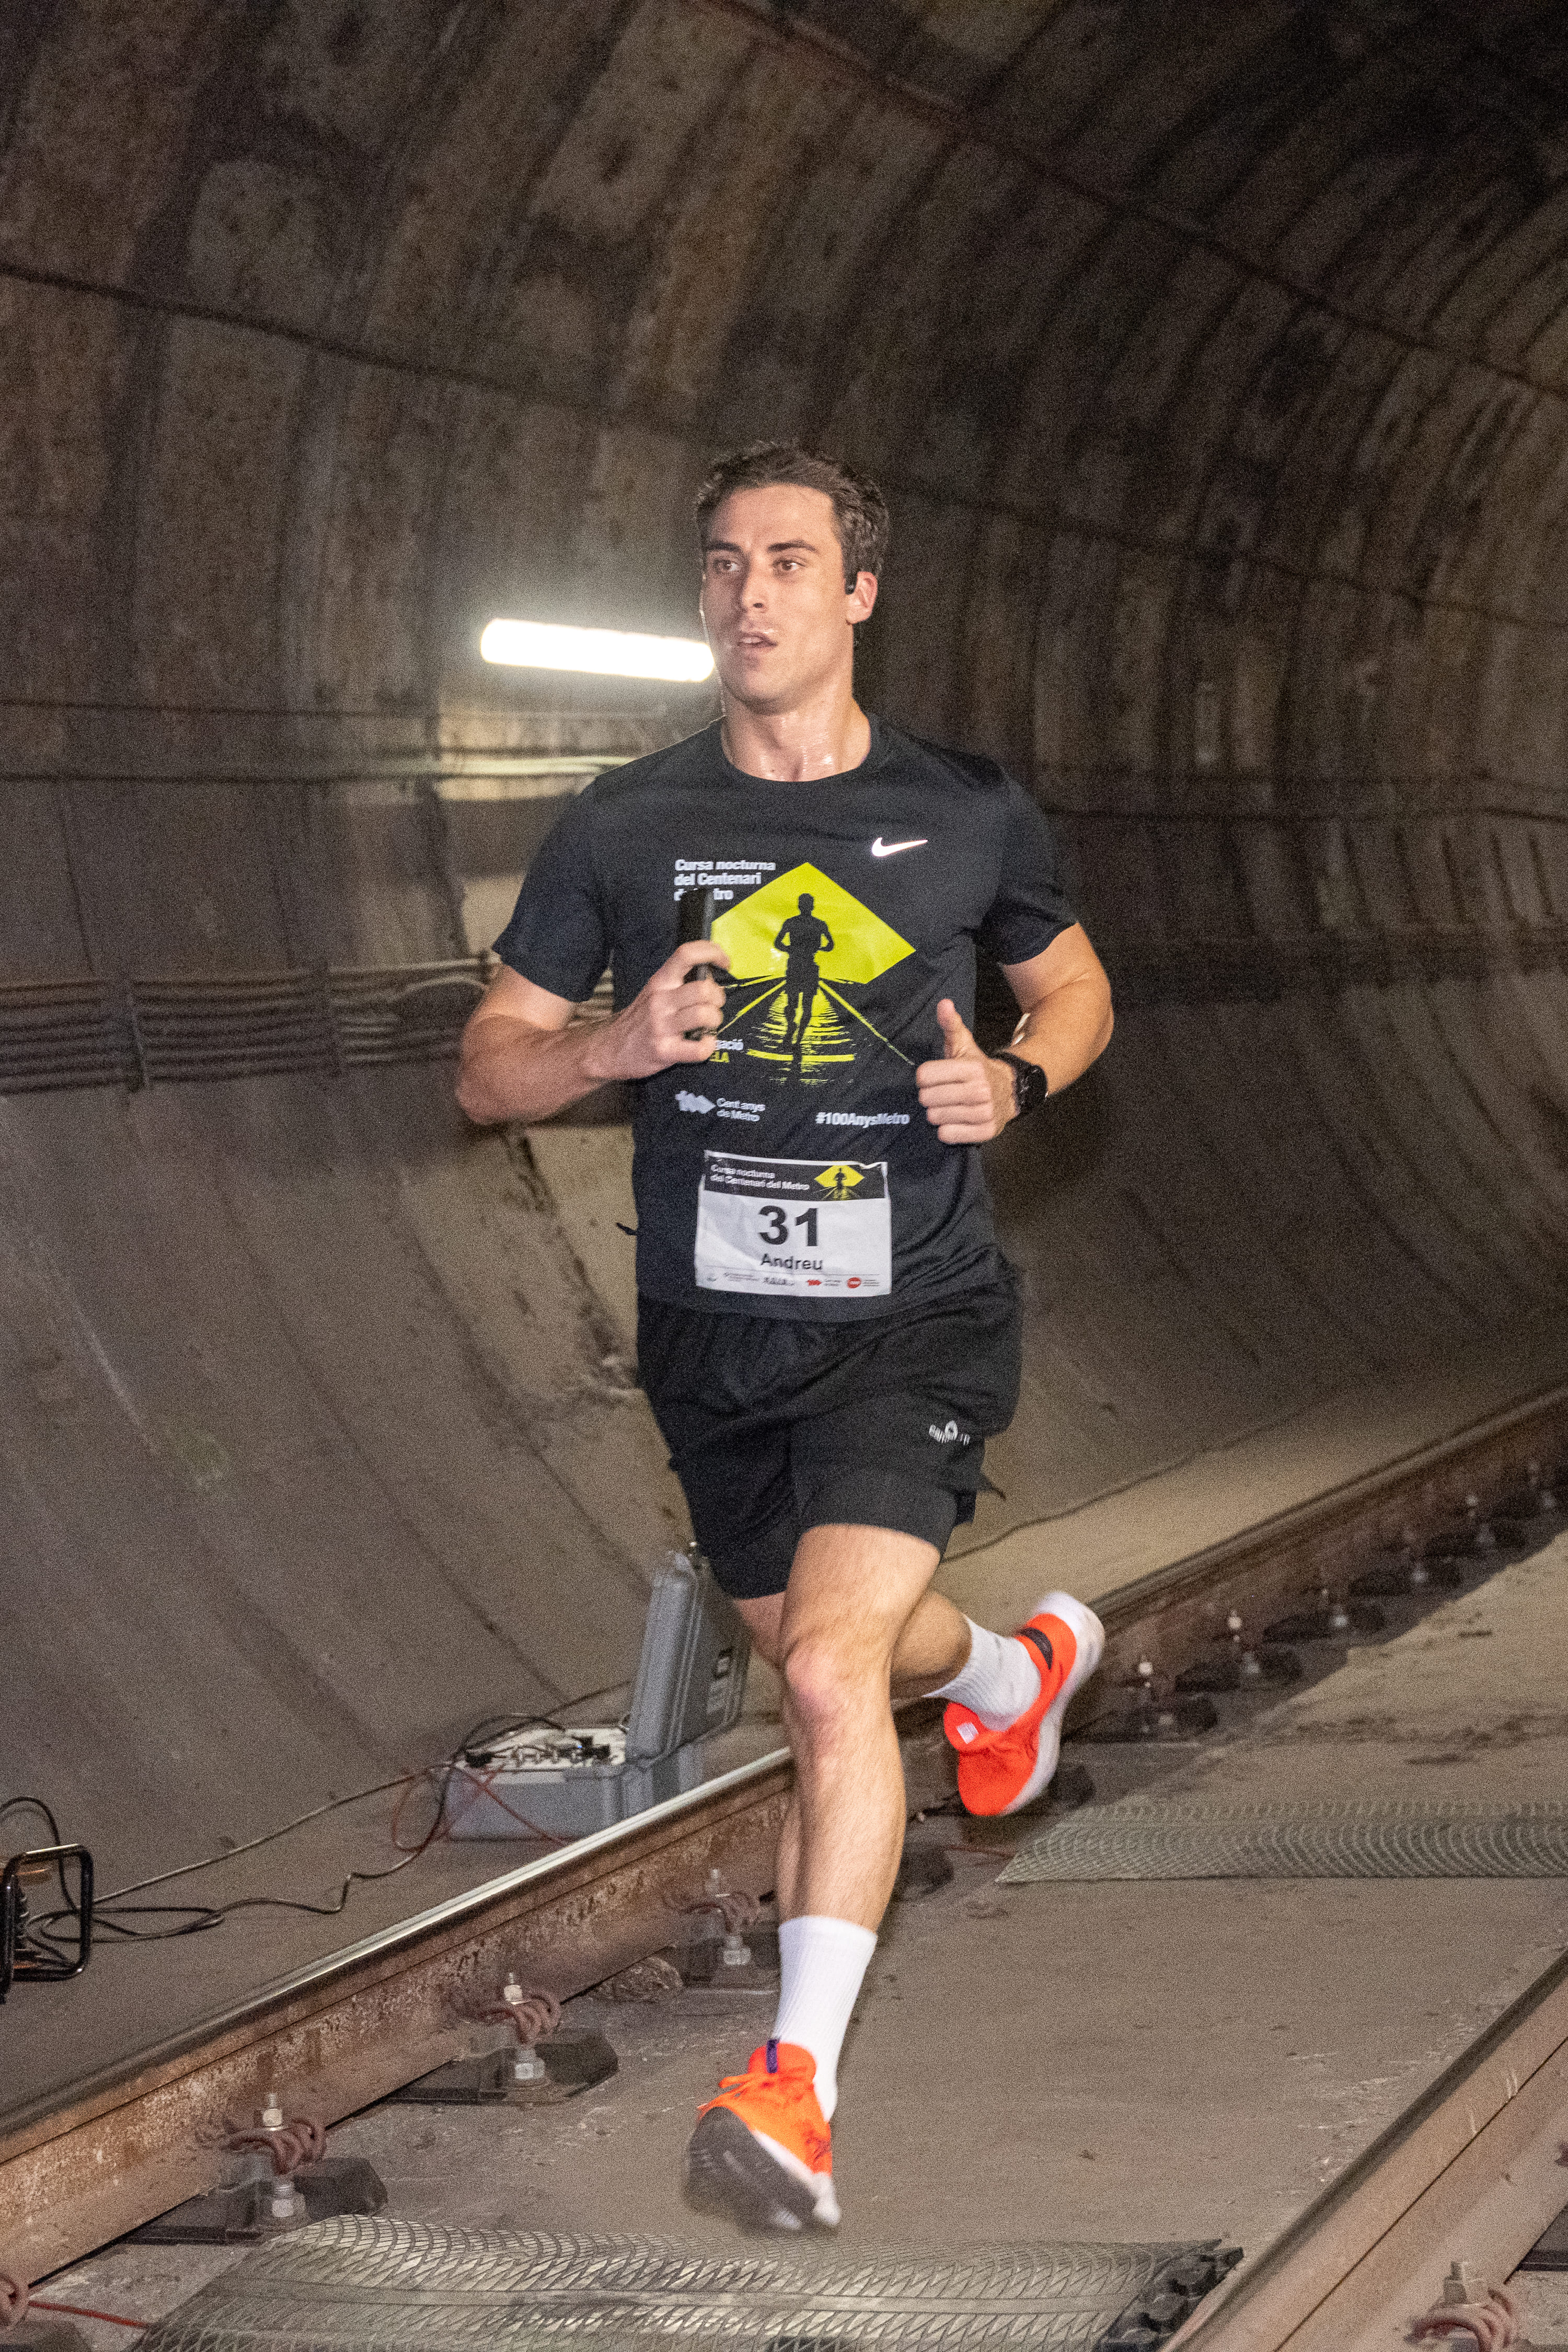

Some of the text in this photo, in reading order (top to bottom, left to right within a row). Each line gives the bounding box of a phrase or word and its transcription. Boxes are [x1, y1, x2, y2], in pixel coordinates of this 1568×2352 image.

[675, 859, 776, 871] Cursa nocturna
[674, 872, 762, 885] del Centenari
[717, 1098, 766, 1113] Cent anys
[717, 1109, 760, 1122] de Metro
[815, 1112, 910, 1128] #100AnysMetro
[711, 1164, 736, 1174] Cursa
[710, 1174, 810, 1190] del Centenari del Metro
[758, 1205, 818, 1247] 31
[760, 1253, 823, 1270] Andreu
